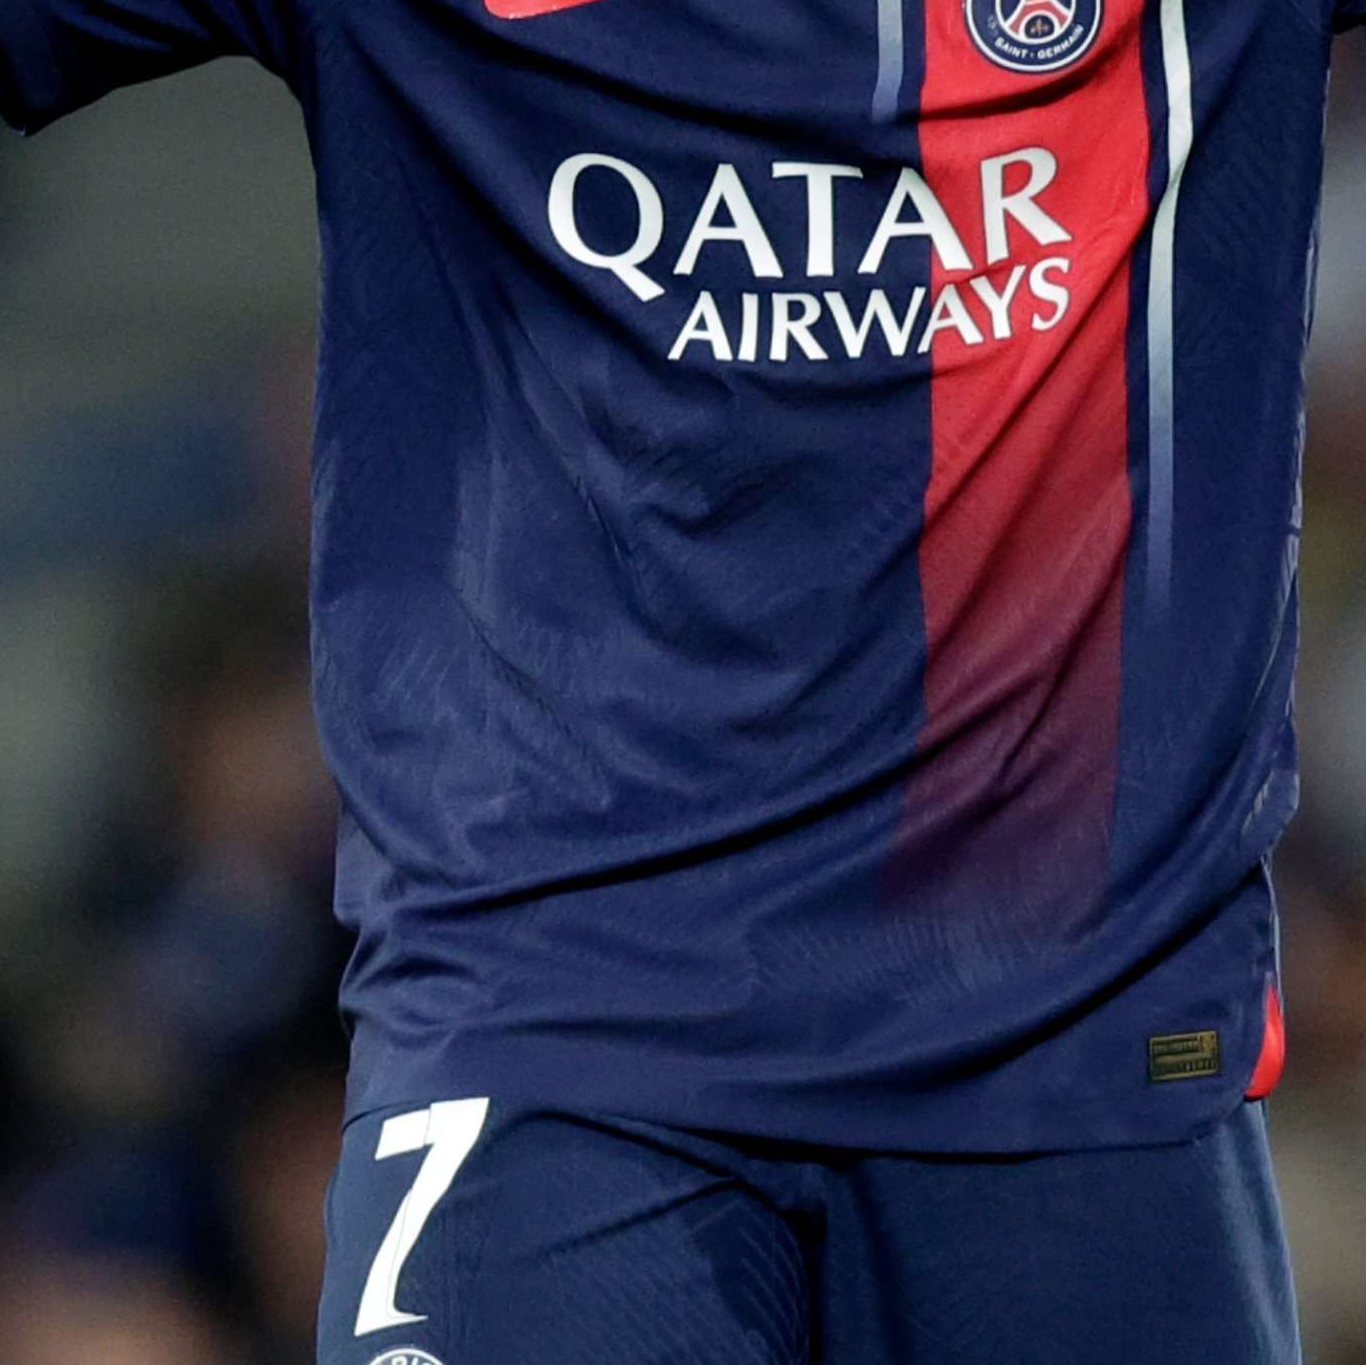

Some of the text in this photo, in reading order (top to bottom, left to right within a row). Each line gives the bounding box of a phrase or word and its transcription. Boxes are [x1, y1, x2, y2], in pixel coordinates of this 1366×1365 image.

[995, 36, 1029, 59] SAINT
[547, 146, 1072, 302] QATAR
[667, 257, 1070, 362] AIRWAYS
[354, 1097, 490, 1337] 7
